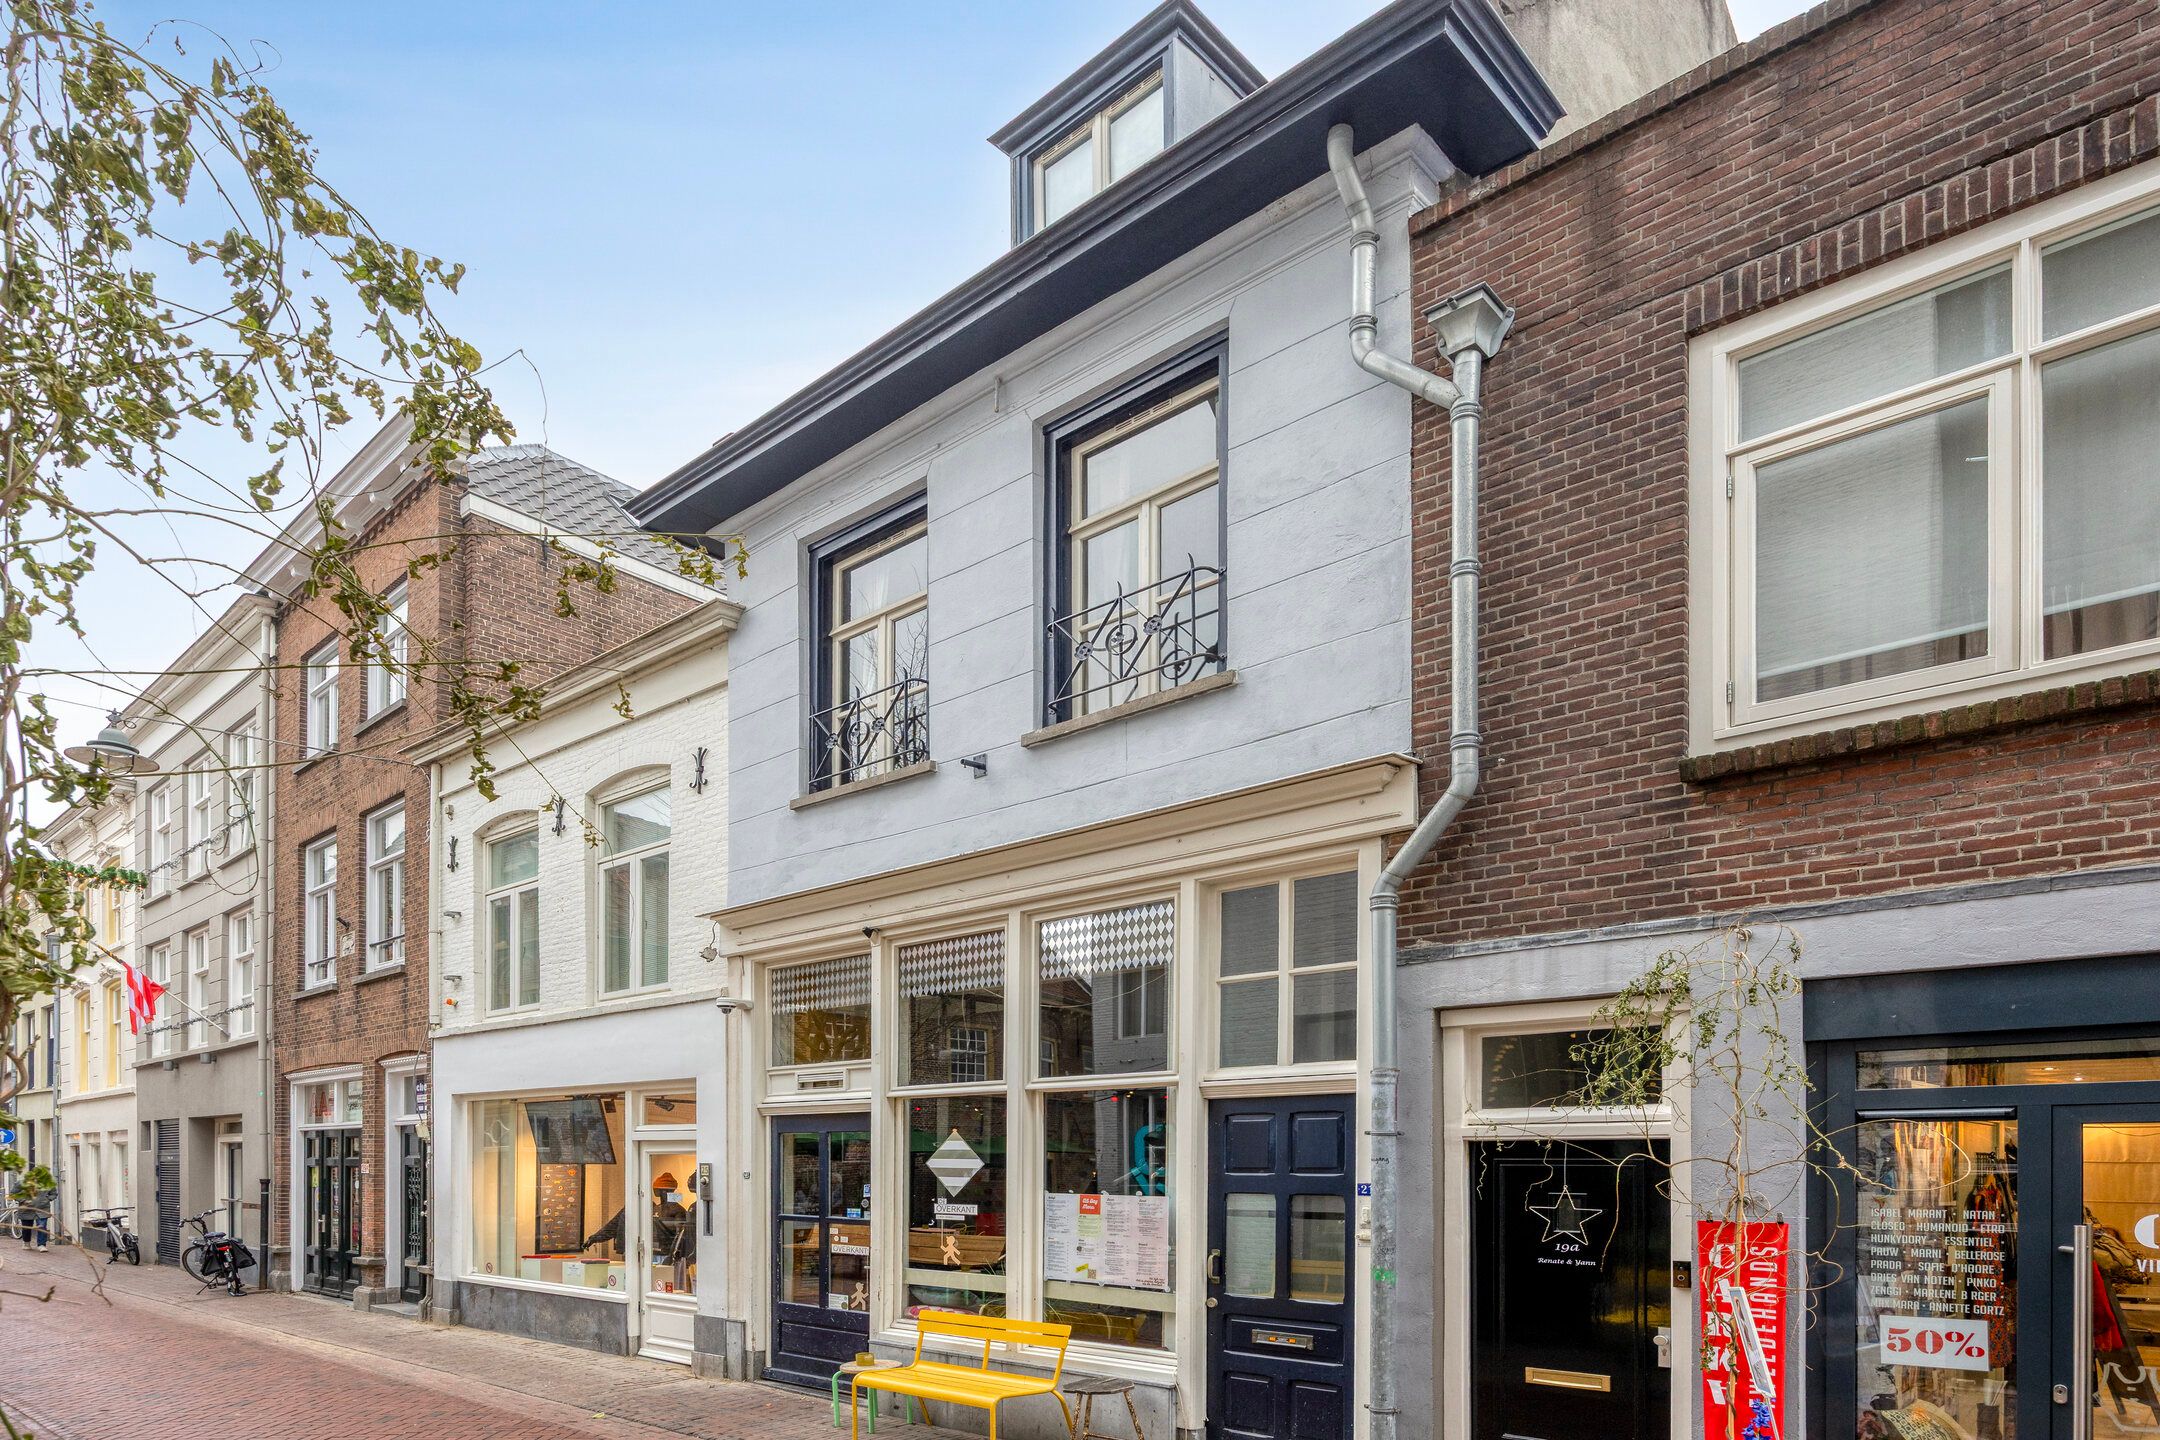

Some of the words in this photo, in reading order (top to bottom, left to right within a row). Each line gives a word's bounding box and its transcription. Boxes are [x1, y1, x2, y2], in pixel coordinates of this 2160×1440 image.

[936, 1204, 976, 1214] OVERKANT
[1871, 1208, 1902, 1218] ISABEL
[1908, 1209, 1948, 1219] MARANT
[1963, 1210, 1996, 1220] NATAN
[1870, 1220, 1905, 1231] CLOSED
[1916, 1222, 1969, 1233] HUMANOID
[1980, 1224, 2005, 1234] ETRO
[1870, 1234, 1927, 1245] HUNKYDORY
[1944, 1236, 1995, 1247] ESSENTIEL
[832, 1245, 868, 1255] OVERKANT
[1554, 1243, 1580, 1253] 19a
[1870, 1247, 1899, 1257] PAUW
[1911, 1248, 1942, 1259] MARNI
[1954, 1250, 2006, 1261] BELLEROSE
[1537, 1257, 1565, 1265] Renate
[1575, 1259, 1596, 1267] Yann
[1870, 1260, 1902, 1270] PRADA
[1918, 1262, 1945, 1272] SOFIE
[1951, 1263, 1995, 1275] D'HOORE
[1870, 1273, 1897, 1283] DRIES
[1901, 1274, 1920, 1284] VAN
[1924, 1275, 1955, 1286] NOTEN
[1966, 1277, 1997, 1288] PINKO
[1870, 1286, 1902, 1296] ZENGGI
[1913, 1287, 1957, 1300] MARLENE
[1892, 1299, 1920, 1310] MARA
[1929, 1302, 1971, 1314] ANNETTE
[1886, 1327, 1985, 1358] 50%
